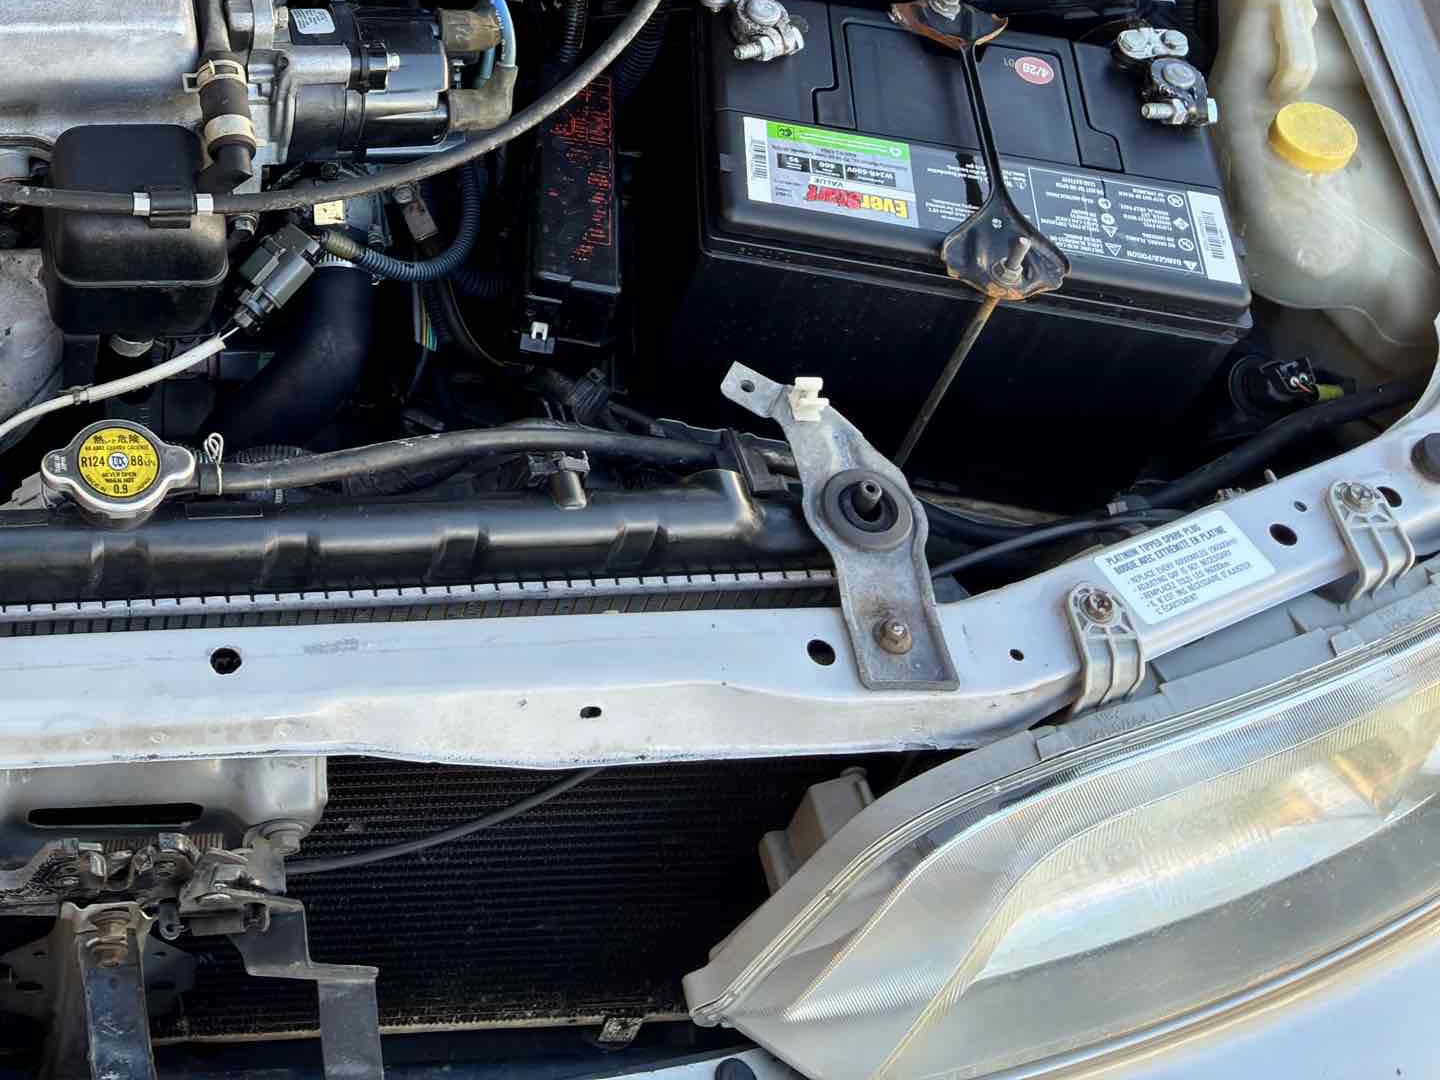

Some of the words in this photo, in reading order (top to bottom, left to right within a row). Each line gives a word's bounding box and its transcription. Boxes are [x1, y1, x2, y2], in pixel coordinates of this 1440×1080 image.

[813, 177, 843, 188] VALUE
[803, 182, 909, 219] EverStart
[81, 456, 106, 468] R124
[113, 484, 129, 494] 0.9
